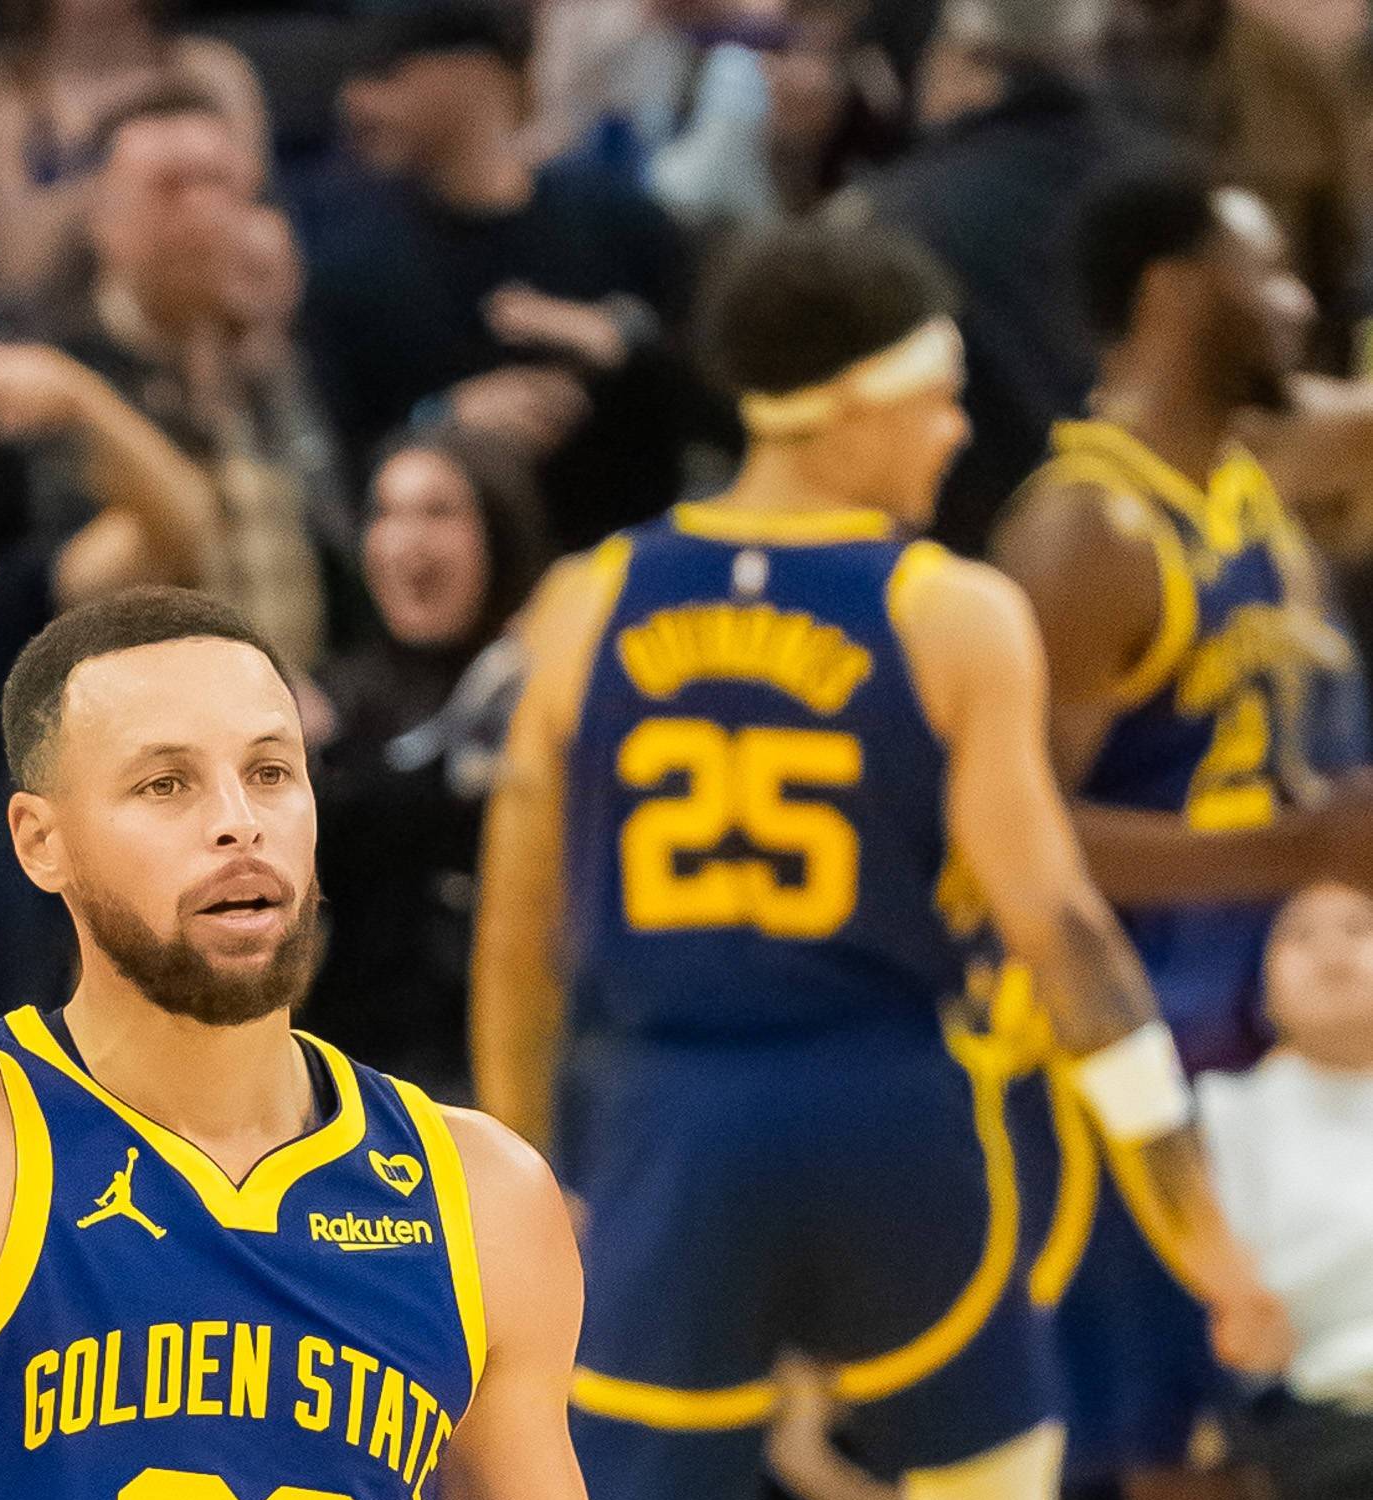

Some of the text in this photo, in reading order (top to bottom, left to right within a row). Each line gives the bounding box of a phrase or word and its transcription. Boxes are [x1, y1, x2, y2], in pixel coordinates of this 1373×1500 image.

[617, 717, 862, 938] 25
[309, 1211, 433, 1244] Rakuten
[24, 1321, 272, 1451] GOLDEN
